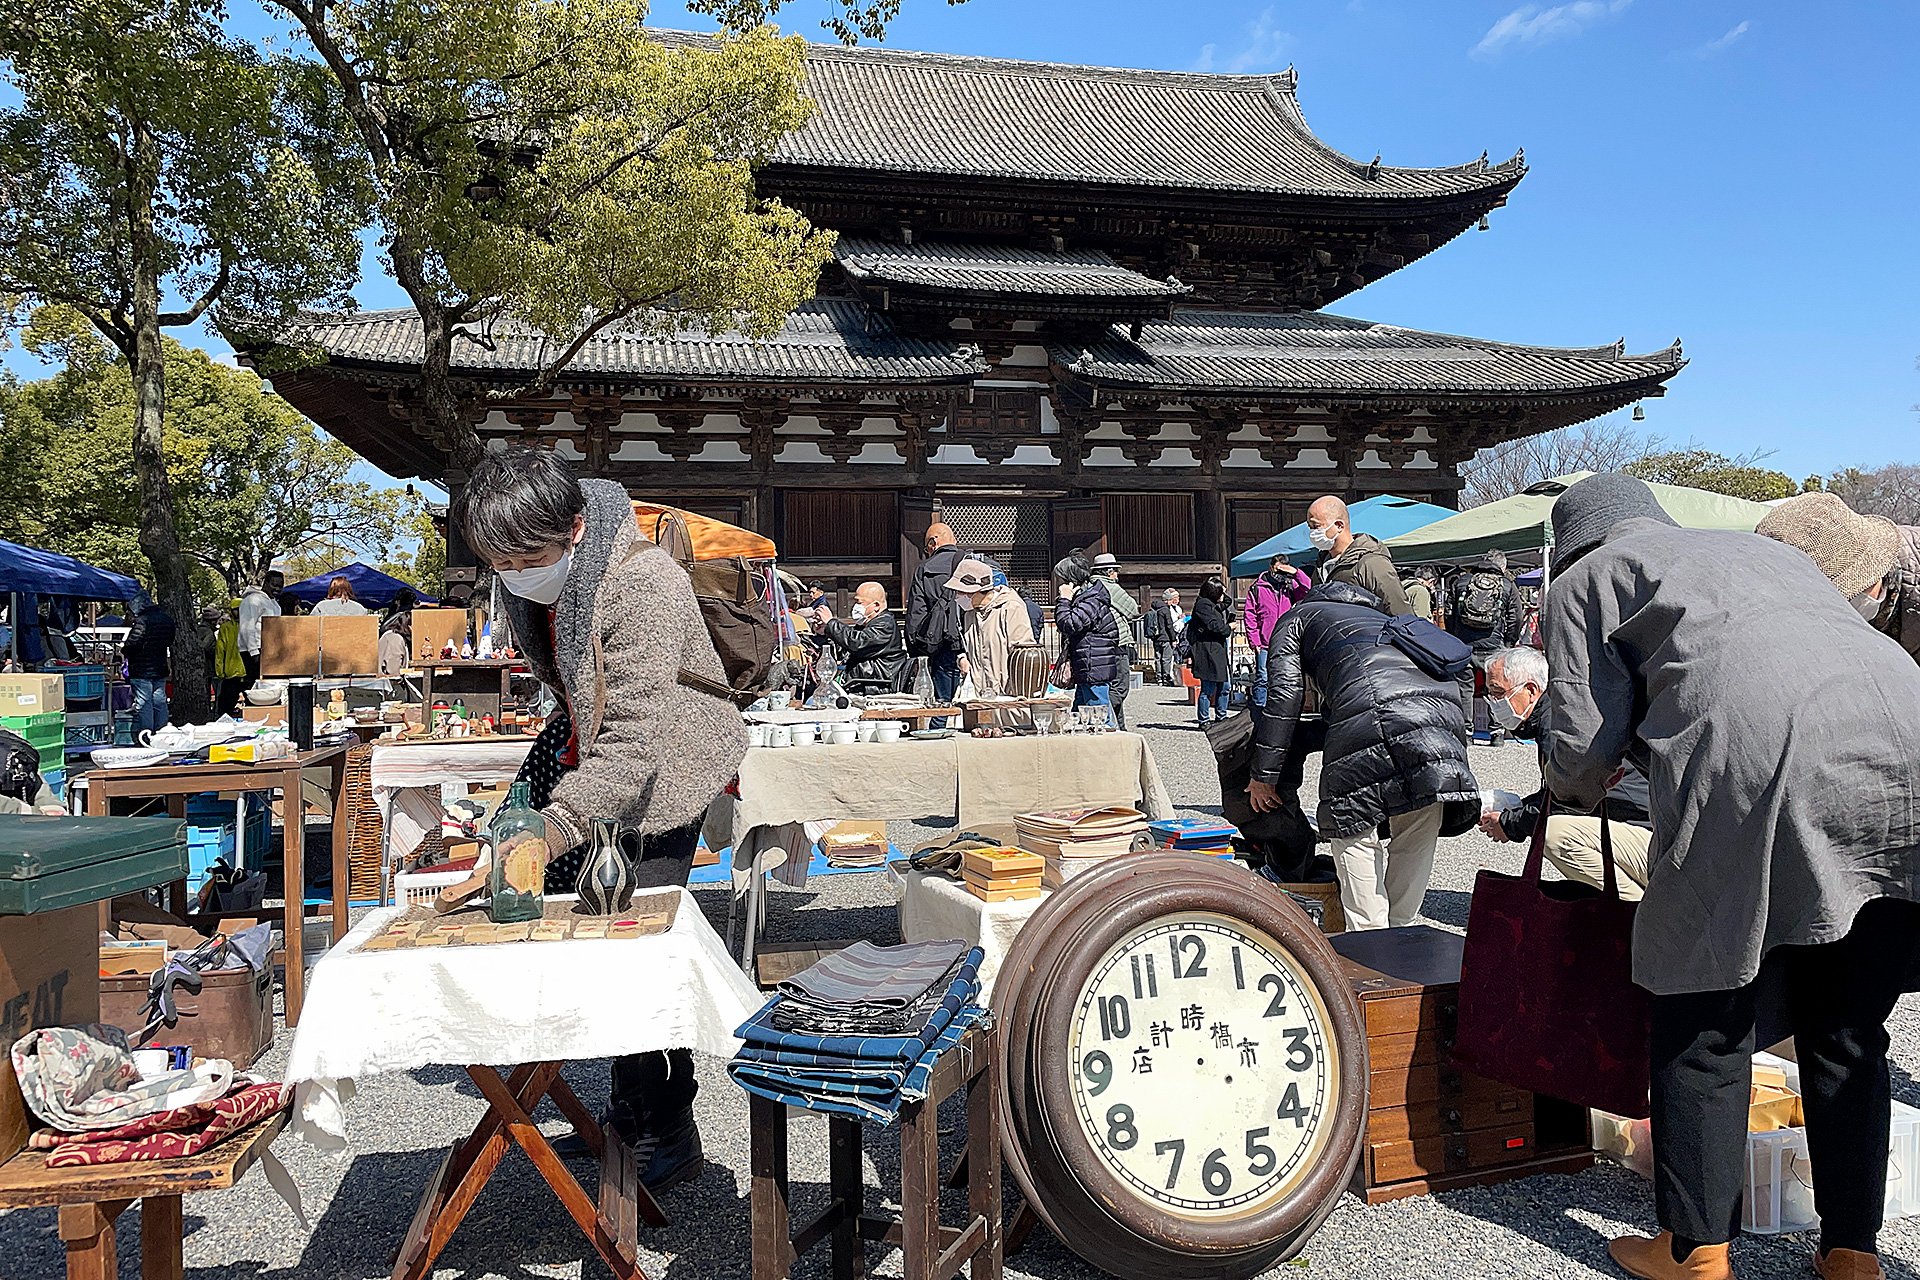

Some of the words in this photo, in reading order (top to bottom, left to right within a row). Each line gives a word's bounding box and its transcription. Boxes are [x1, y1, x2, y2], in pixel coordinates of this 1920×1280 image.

[1130, 953, 1158, 999] 11
[1168, 934, 1208, 980] 12
[1231, 945, 1246, 990] 1
[1097, 994, 1131, 1041] 10
[1257, 973, 1287, 1019] 2
[1282, 1026, 1314, 1073] 3
[1082, 1049, 1113, 1098] 9
[1105, 1103, 1139, 1151] 8
[1276, 1081, 1311, 1129] 4
[1154, 1138, 1186, 1190] 7
[1201, 1147, 1232, 1197] 6
[1245, 1126, 1277, 1177] 5
